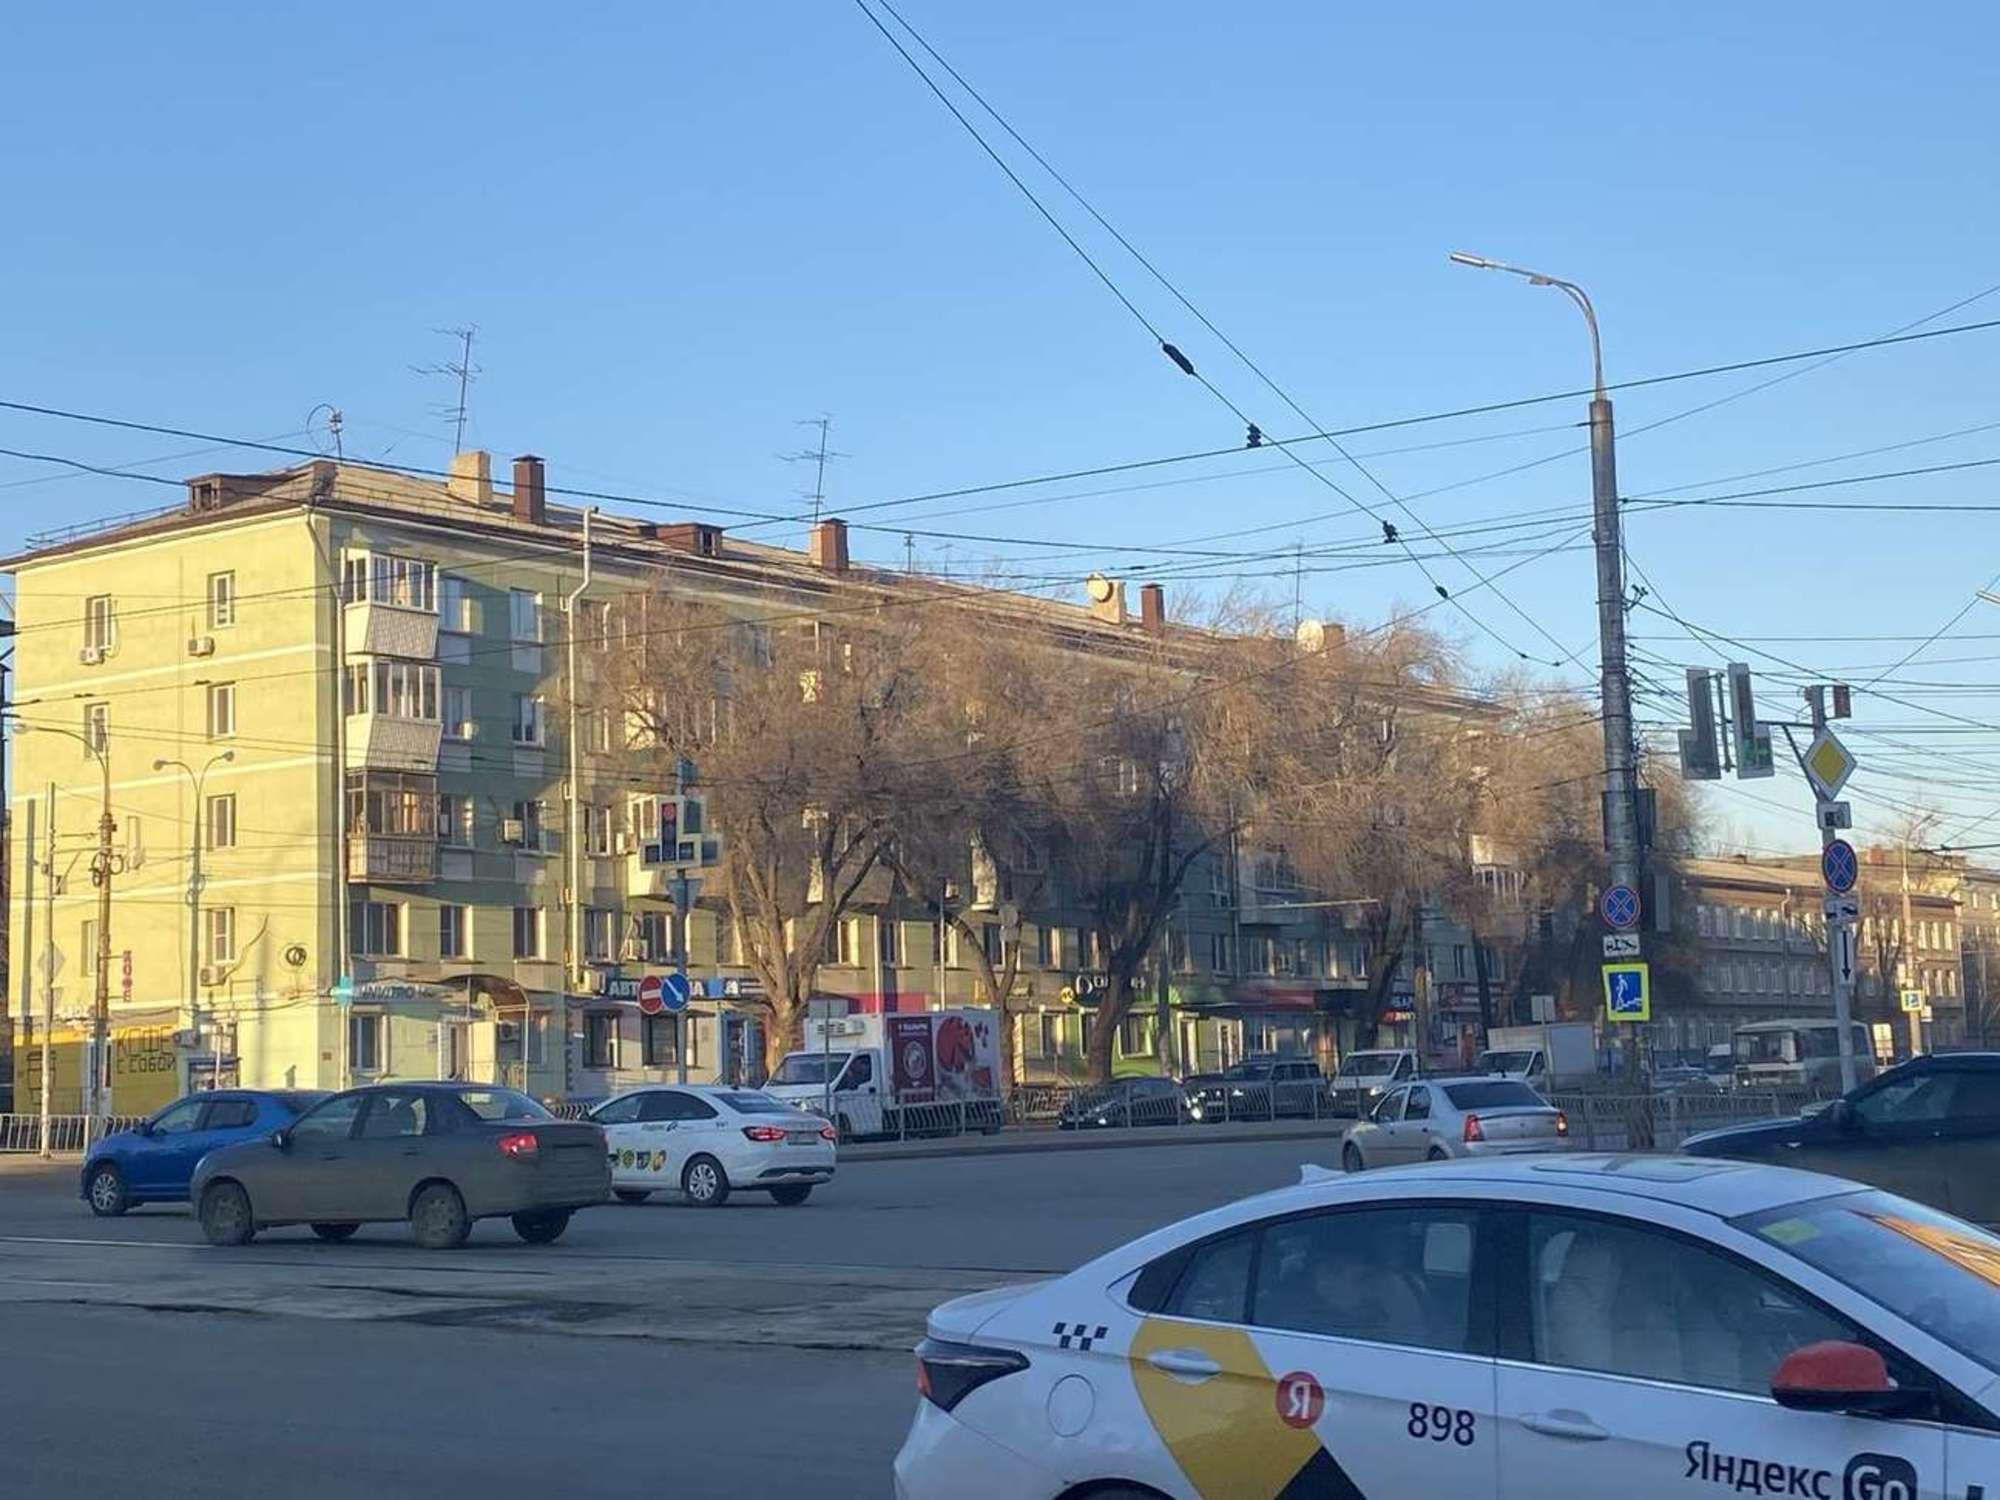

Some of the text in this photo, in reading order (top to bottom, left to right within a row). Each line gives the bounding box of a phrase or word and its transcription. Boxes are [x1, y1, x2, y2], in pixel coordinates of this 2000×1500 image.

[1286, 1379, 1312, 1420] Я
[1407, 1402, 1475, 1447] 898
[1684, 1440, 1909, 1500] Яндекс Go
